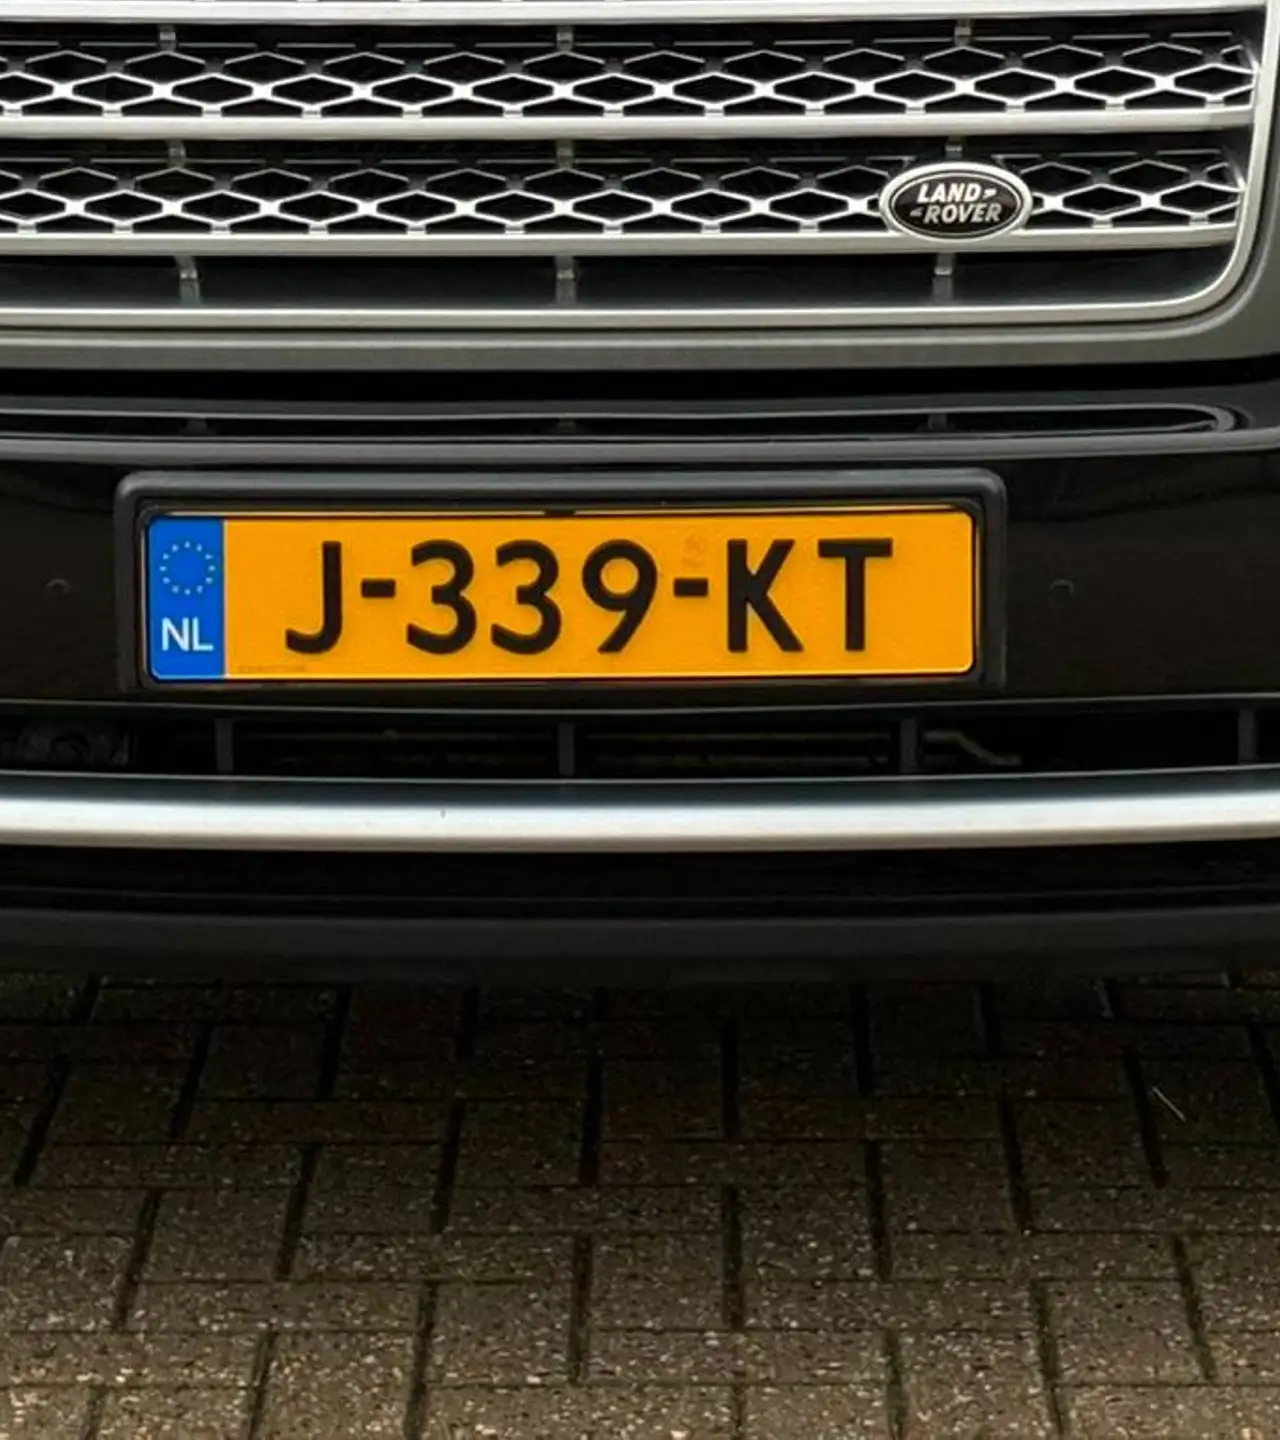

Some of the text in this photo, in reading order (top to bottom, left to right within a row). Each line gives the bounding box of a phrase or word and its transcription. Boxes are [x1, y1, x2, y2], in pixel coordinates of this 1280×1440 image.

[917, 183, 982, 204] LAND
[923, 202, 1003, 224] ROVER
[161, 538, 894, 655] NL J-339-KT
